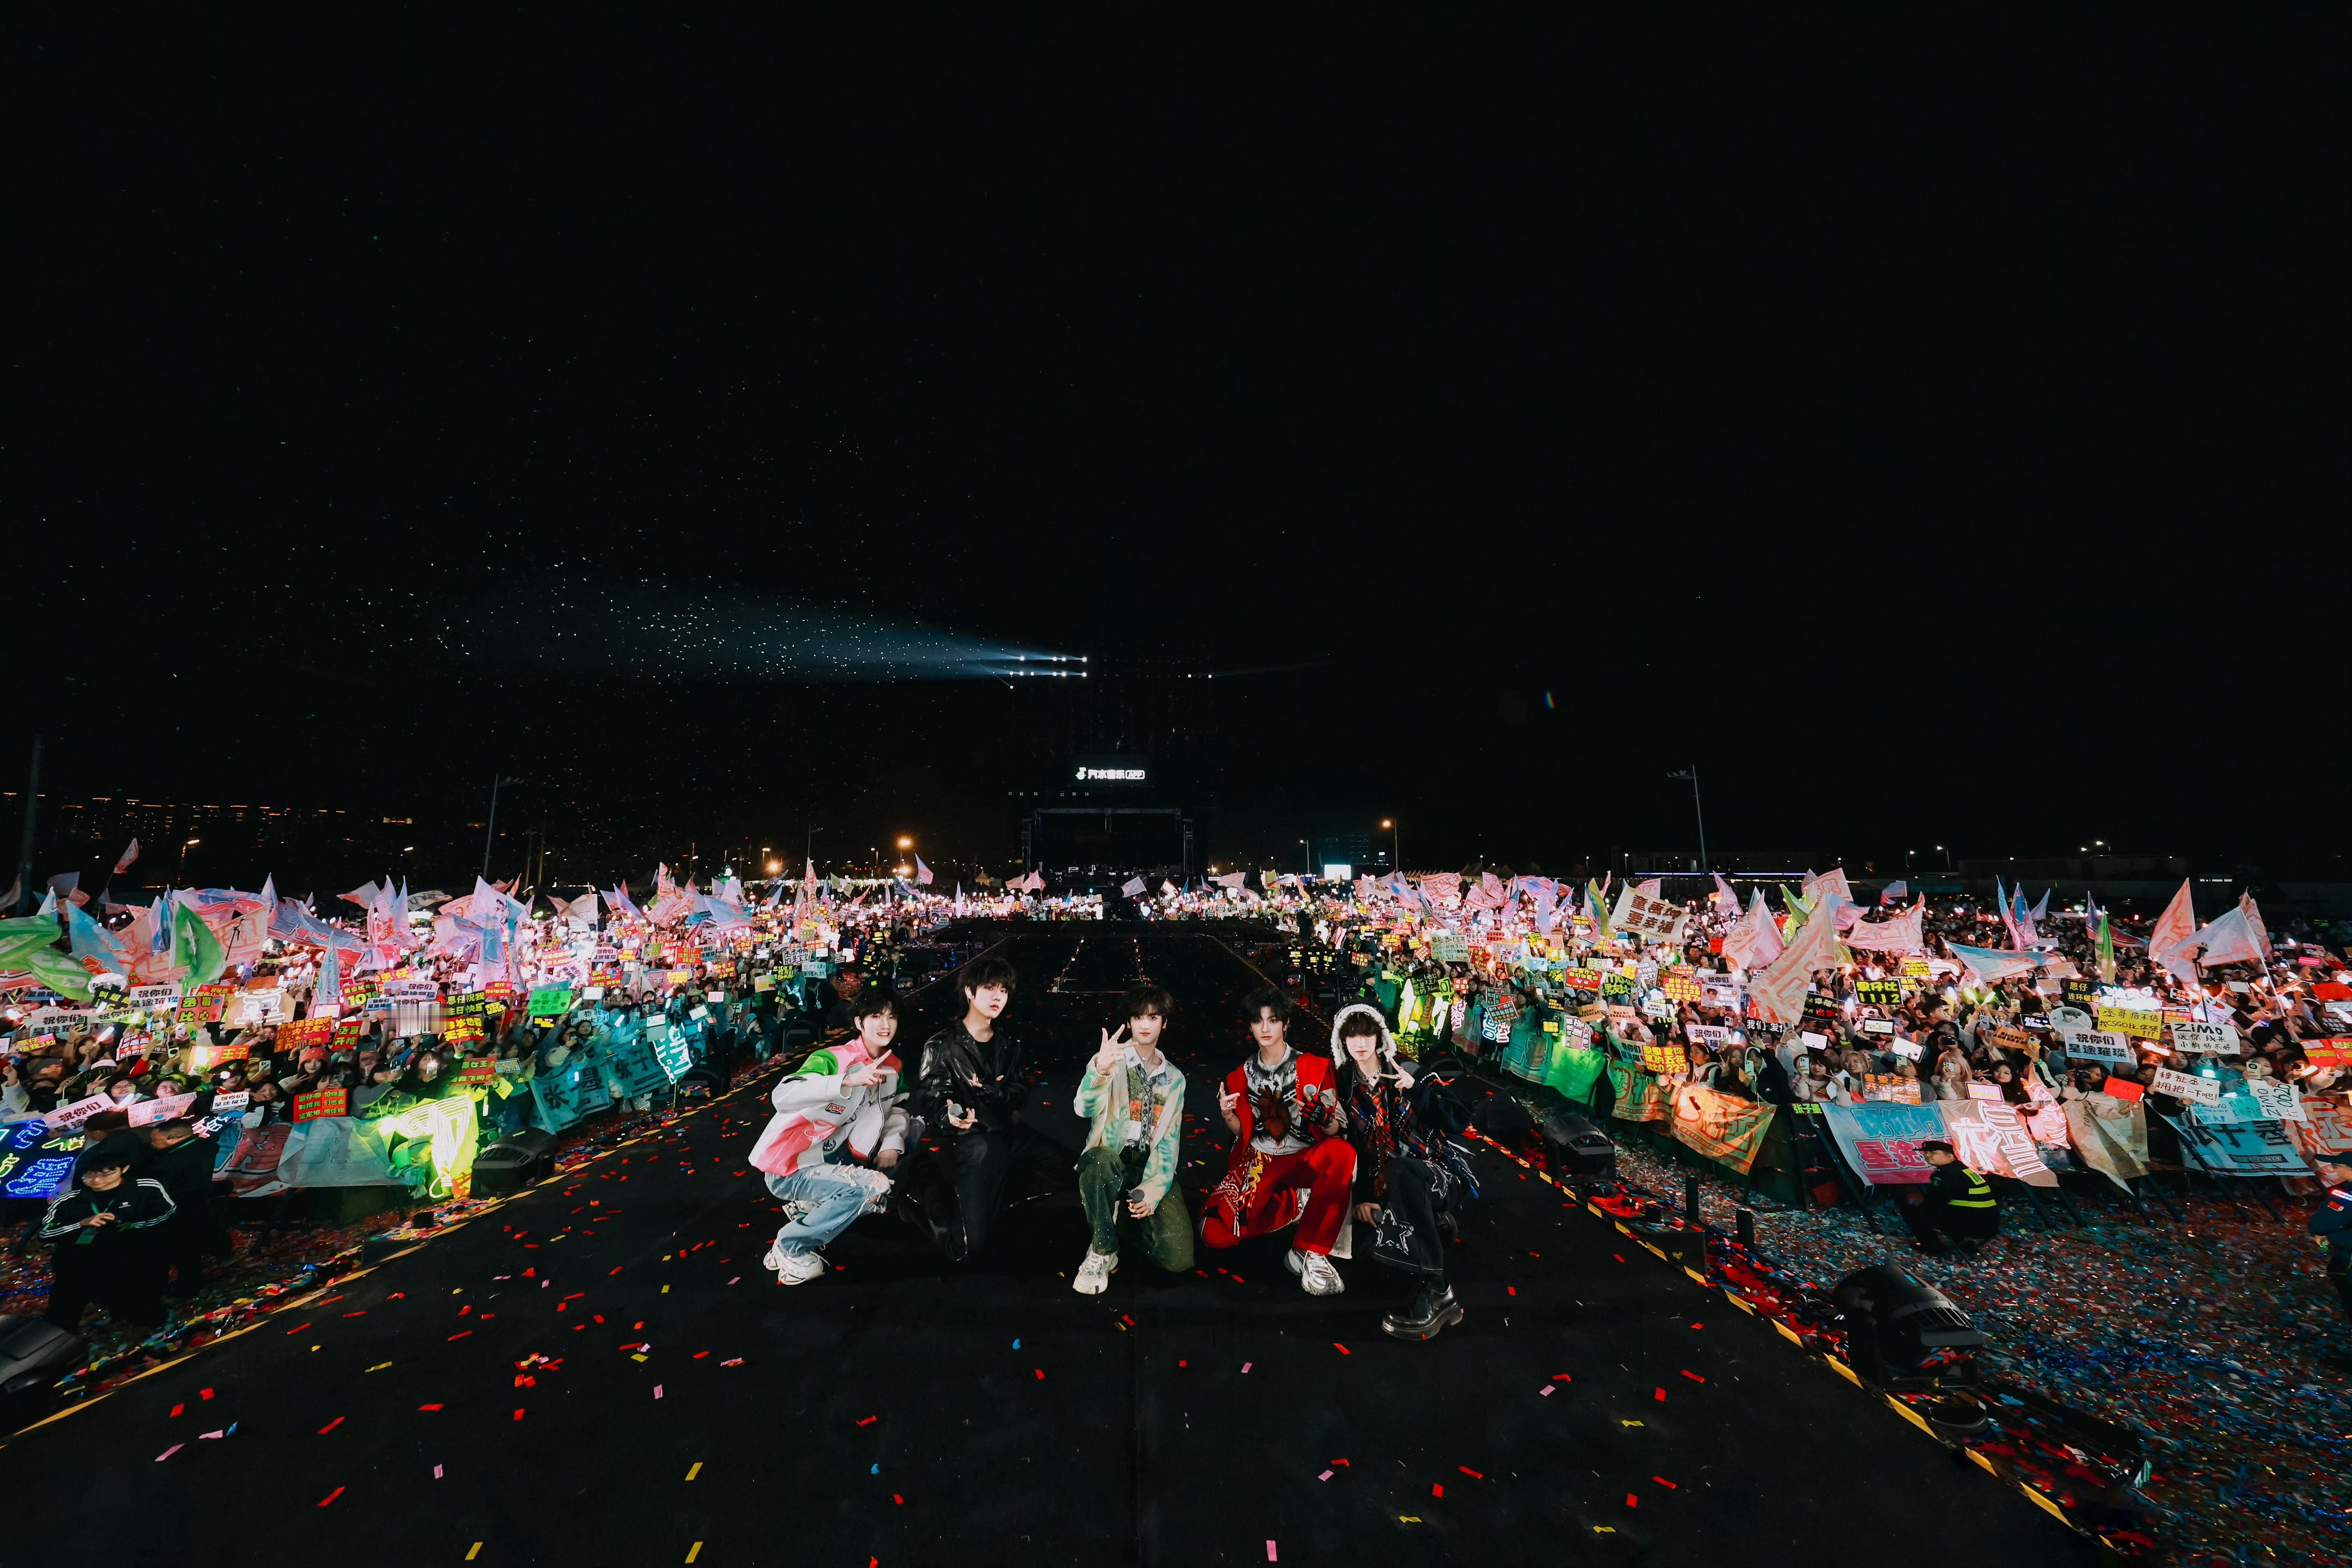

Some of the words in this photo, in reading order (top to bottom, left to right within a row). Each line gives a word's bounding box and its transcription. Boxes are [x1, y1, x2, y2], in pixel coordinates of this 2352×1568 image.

[1088, 769, 1125, 779] 汽水音乐
[1626, 910, 1675, 935] 要幸福
[2070, 982, 2088, 991] 恩仔
[138, 988, 172, 998] 祝你们
[1859, 993, 1901, 1003] 1112
[182, 997, 212, 1008] 丞哥
[178, 1011, 210, 1022] 比心
[1746, 1019, 1767, 1031] 我们
[1695, 1029, 1721, 1038] 祝你们
[2076, 1033, 2115, 1046] 祝你们
[2068, 1043, 2126, 1058] 星途璀璨
[2159, 1071, 2200, 1087] 穆祉丞
[58, 1102, 102, 1123] 祝你们
[828, 1104, 845, 1113] PUNK24
[1792, 1103, 1823, 1115] 张子墨
[1850, 1106, 1947, 1138] 祝你们
